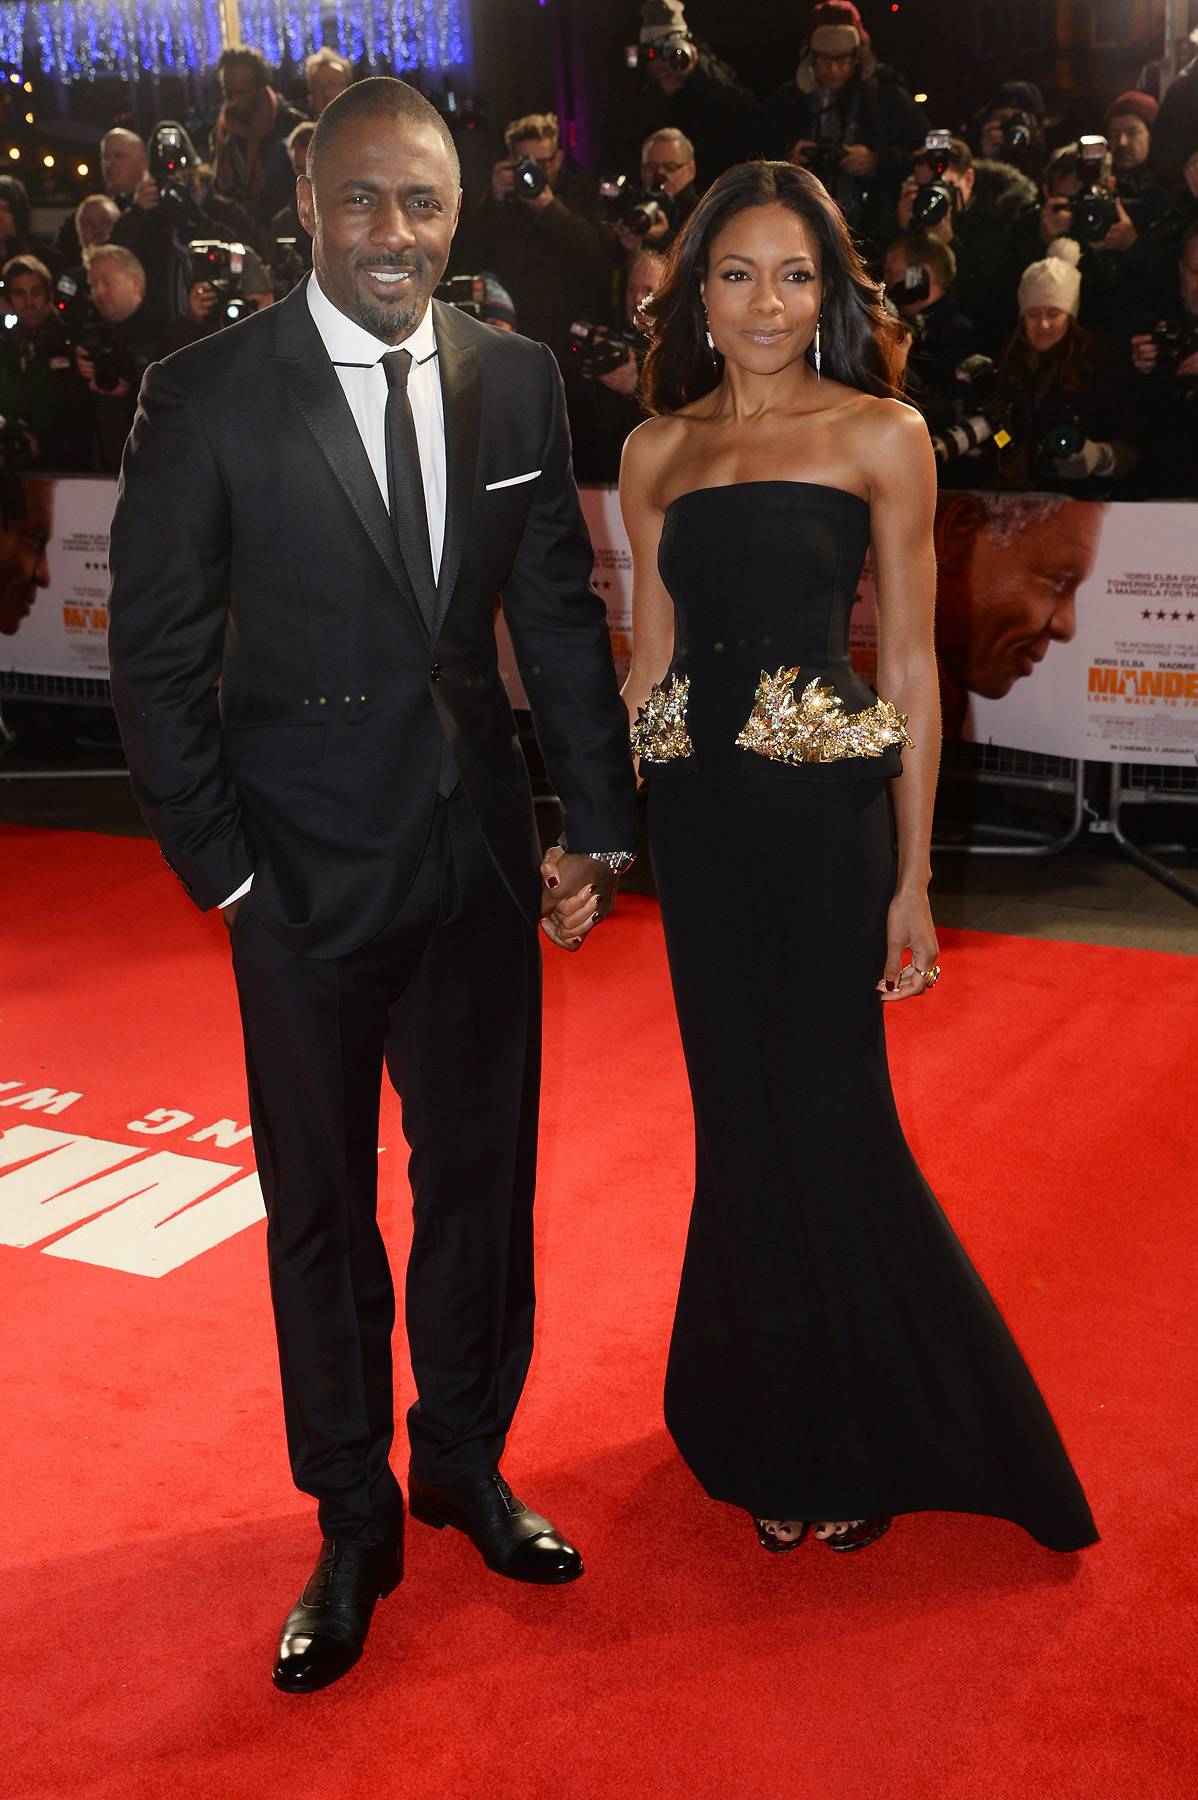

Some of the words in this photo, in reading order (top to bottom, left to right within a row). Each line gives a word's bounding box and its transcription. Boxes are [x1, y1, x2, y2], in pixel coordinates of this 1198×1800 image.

[1115, 588, 1161, 597] MANDELA
[1160, 582, 1198, 590] PERFOR
[63, 608, 108, 630] MAN
[1094, 658, 1119, 667] IDRIS
[1121, 660, 1145, 668] ELBA
[1158, 661, 1196, 670] NAOMIE
[1088, 667, 1198, 699] MANDE
[0, 1081, 83, 1114] W
[127, 1108, 252, 1148] NG
